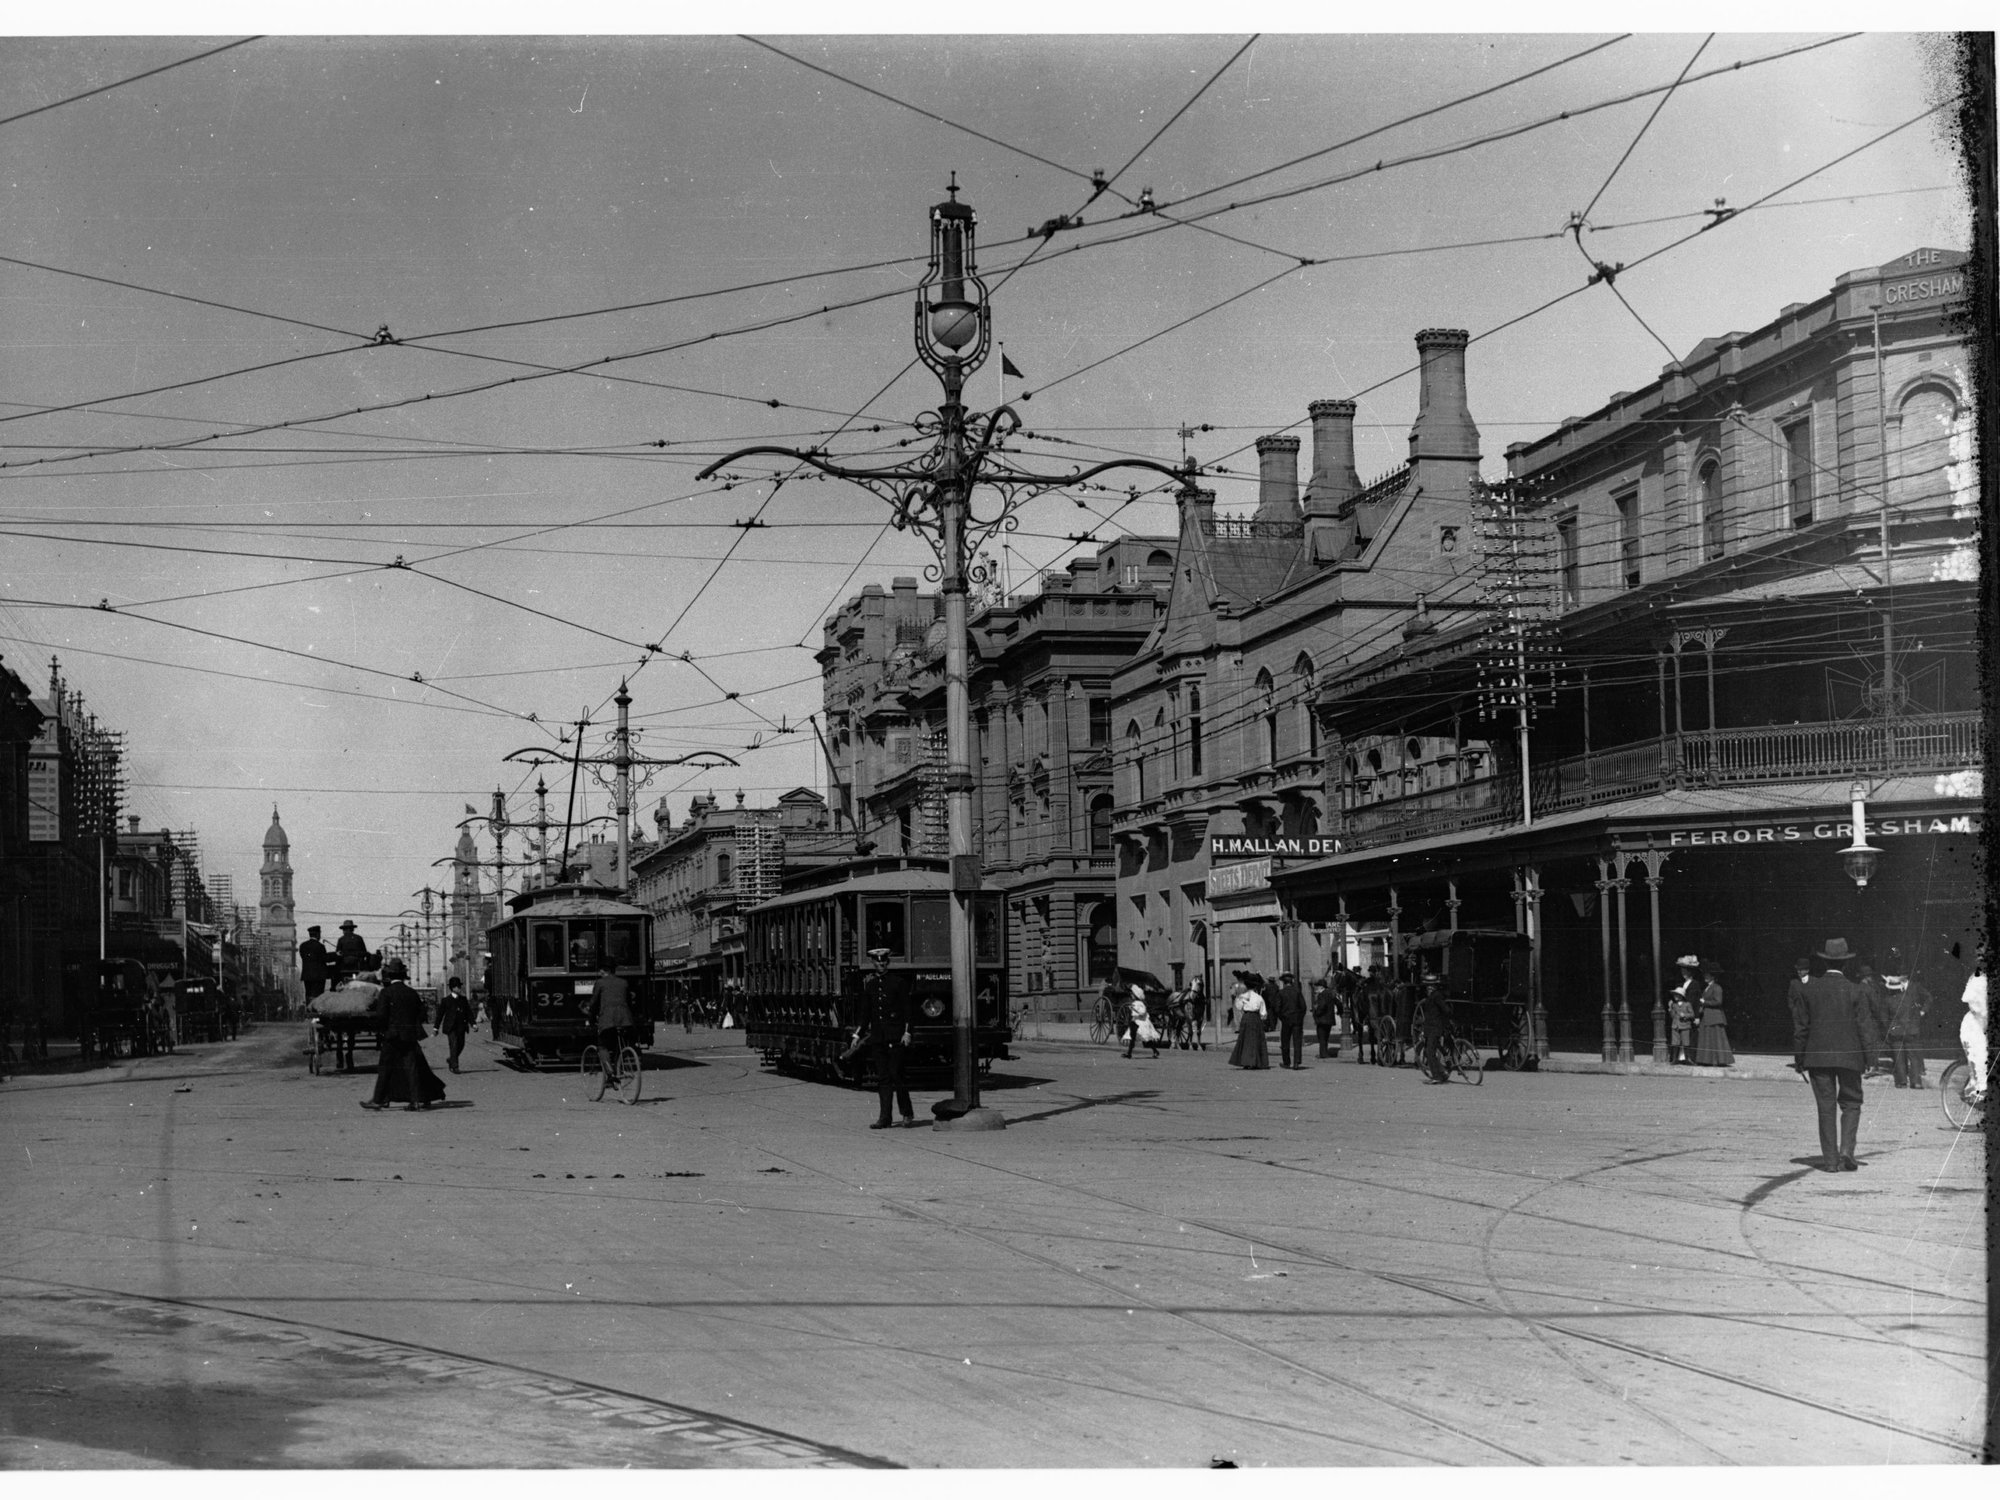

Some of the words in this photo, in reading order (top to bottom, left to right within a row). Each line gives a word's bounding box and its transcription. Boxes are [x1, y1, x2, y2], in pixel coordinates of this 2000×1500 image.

[1904, 250, 1941, 267] THE
[1886, 275, 1965, 304] GRESHAM
[1670, 826, 1801, 846] FEROR'S
[537, 992, 564, 1006] 32
[977, 988, 995, 1004] 4
